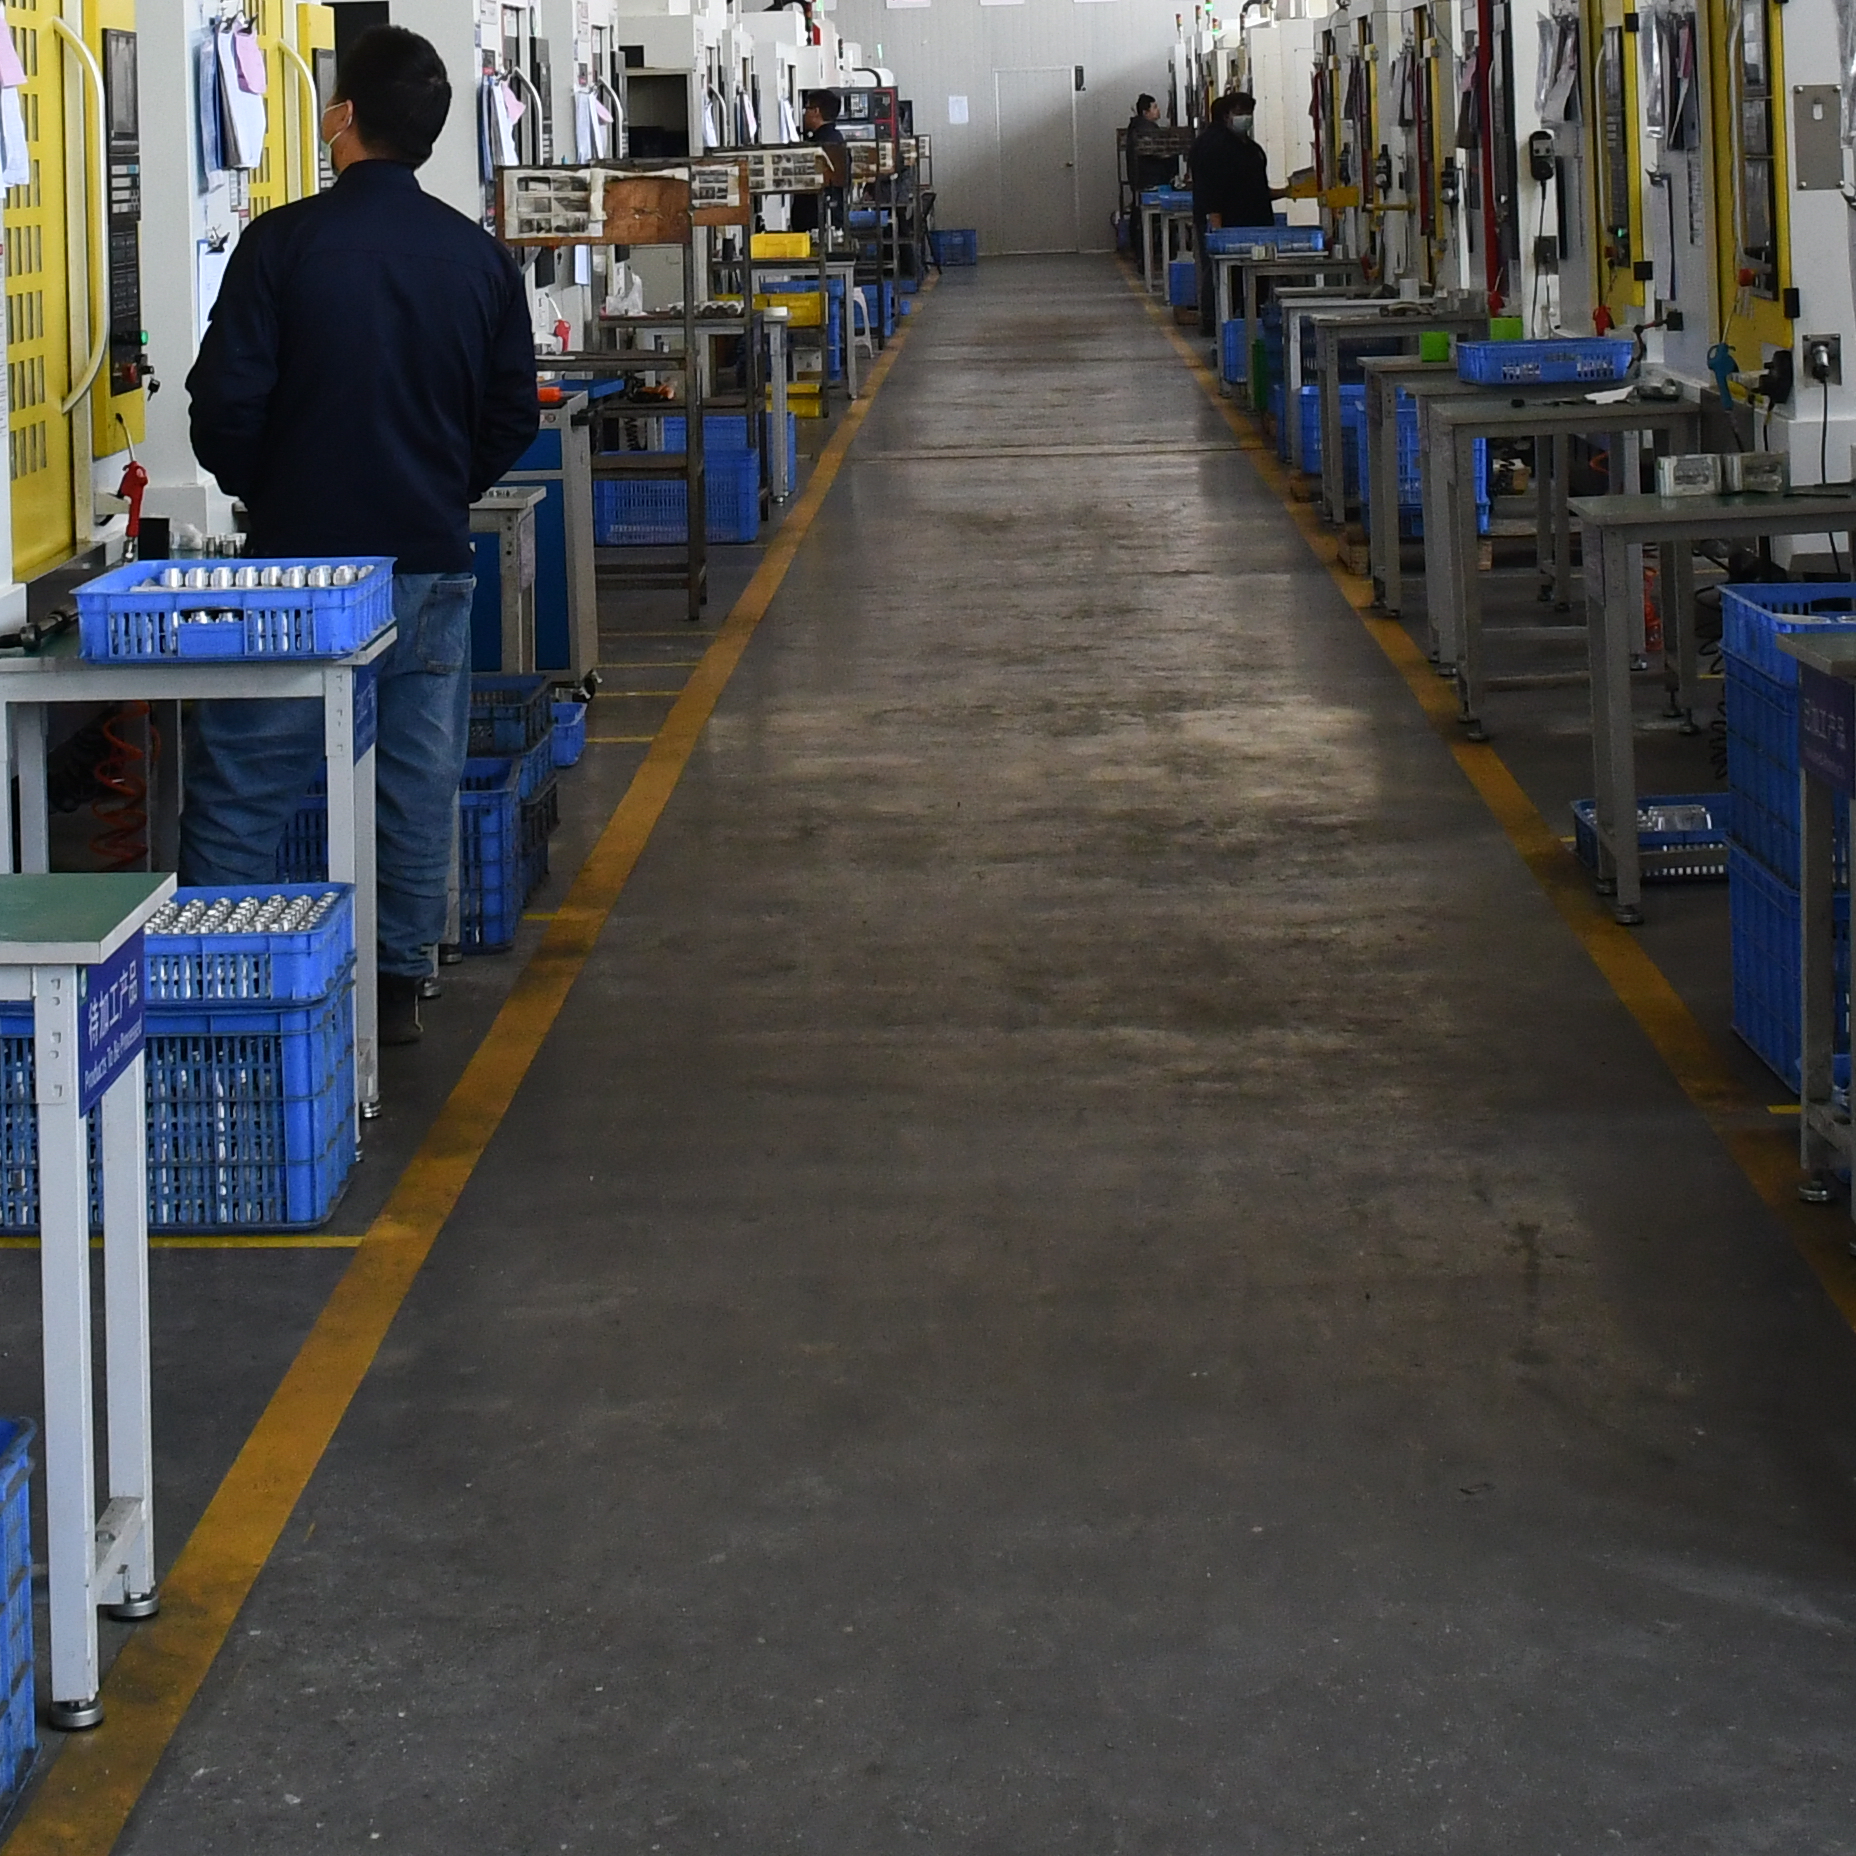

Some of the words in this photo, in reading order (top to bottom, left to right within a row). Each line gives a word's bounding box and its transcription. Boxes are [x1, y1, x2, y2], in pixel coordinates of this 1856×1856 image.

[88, 959, 138, 1052] 待加工产品
